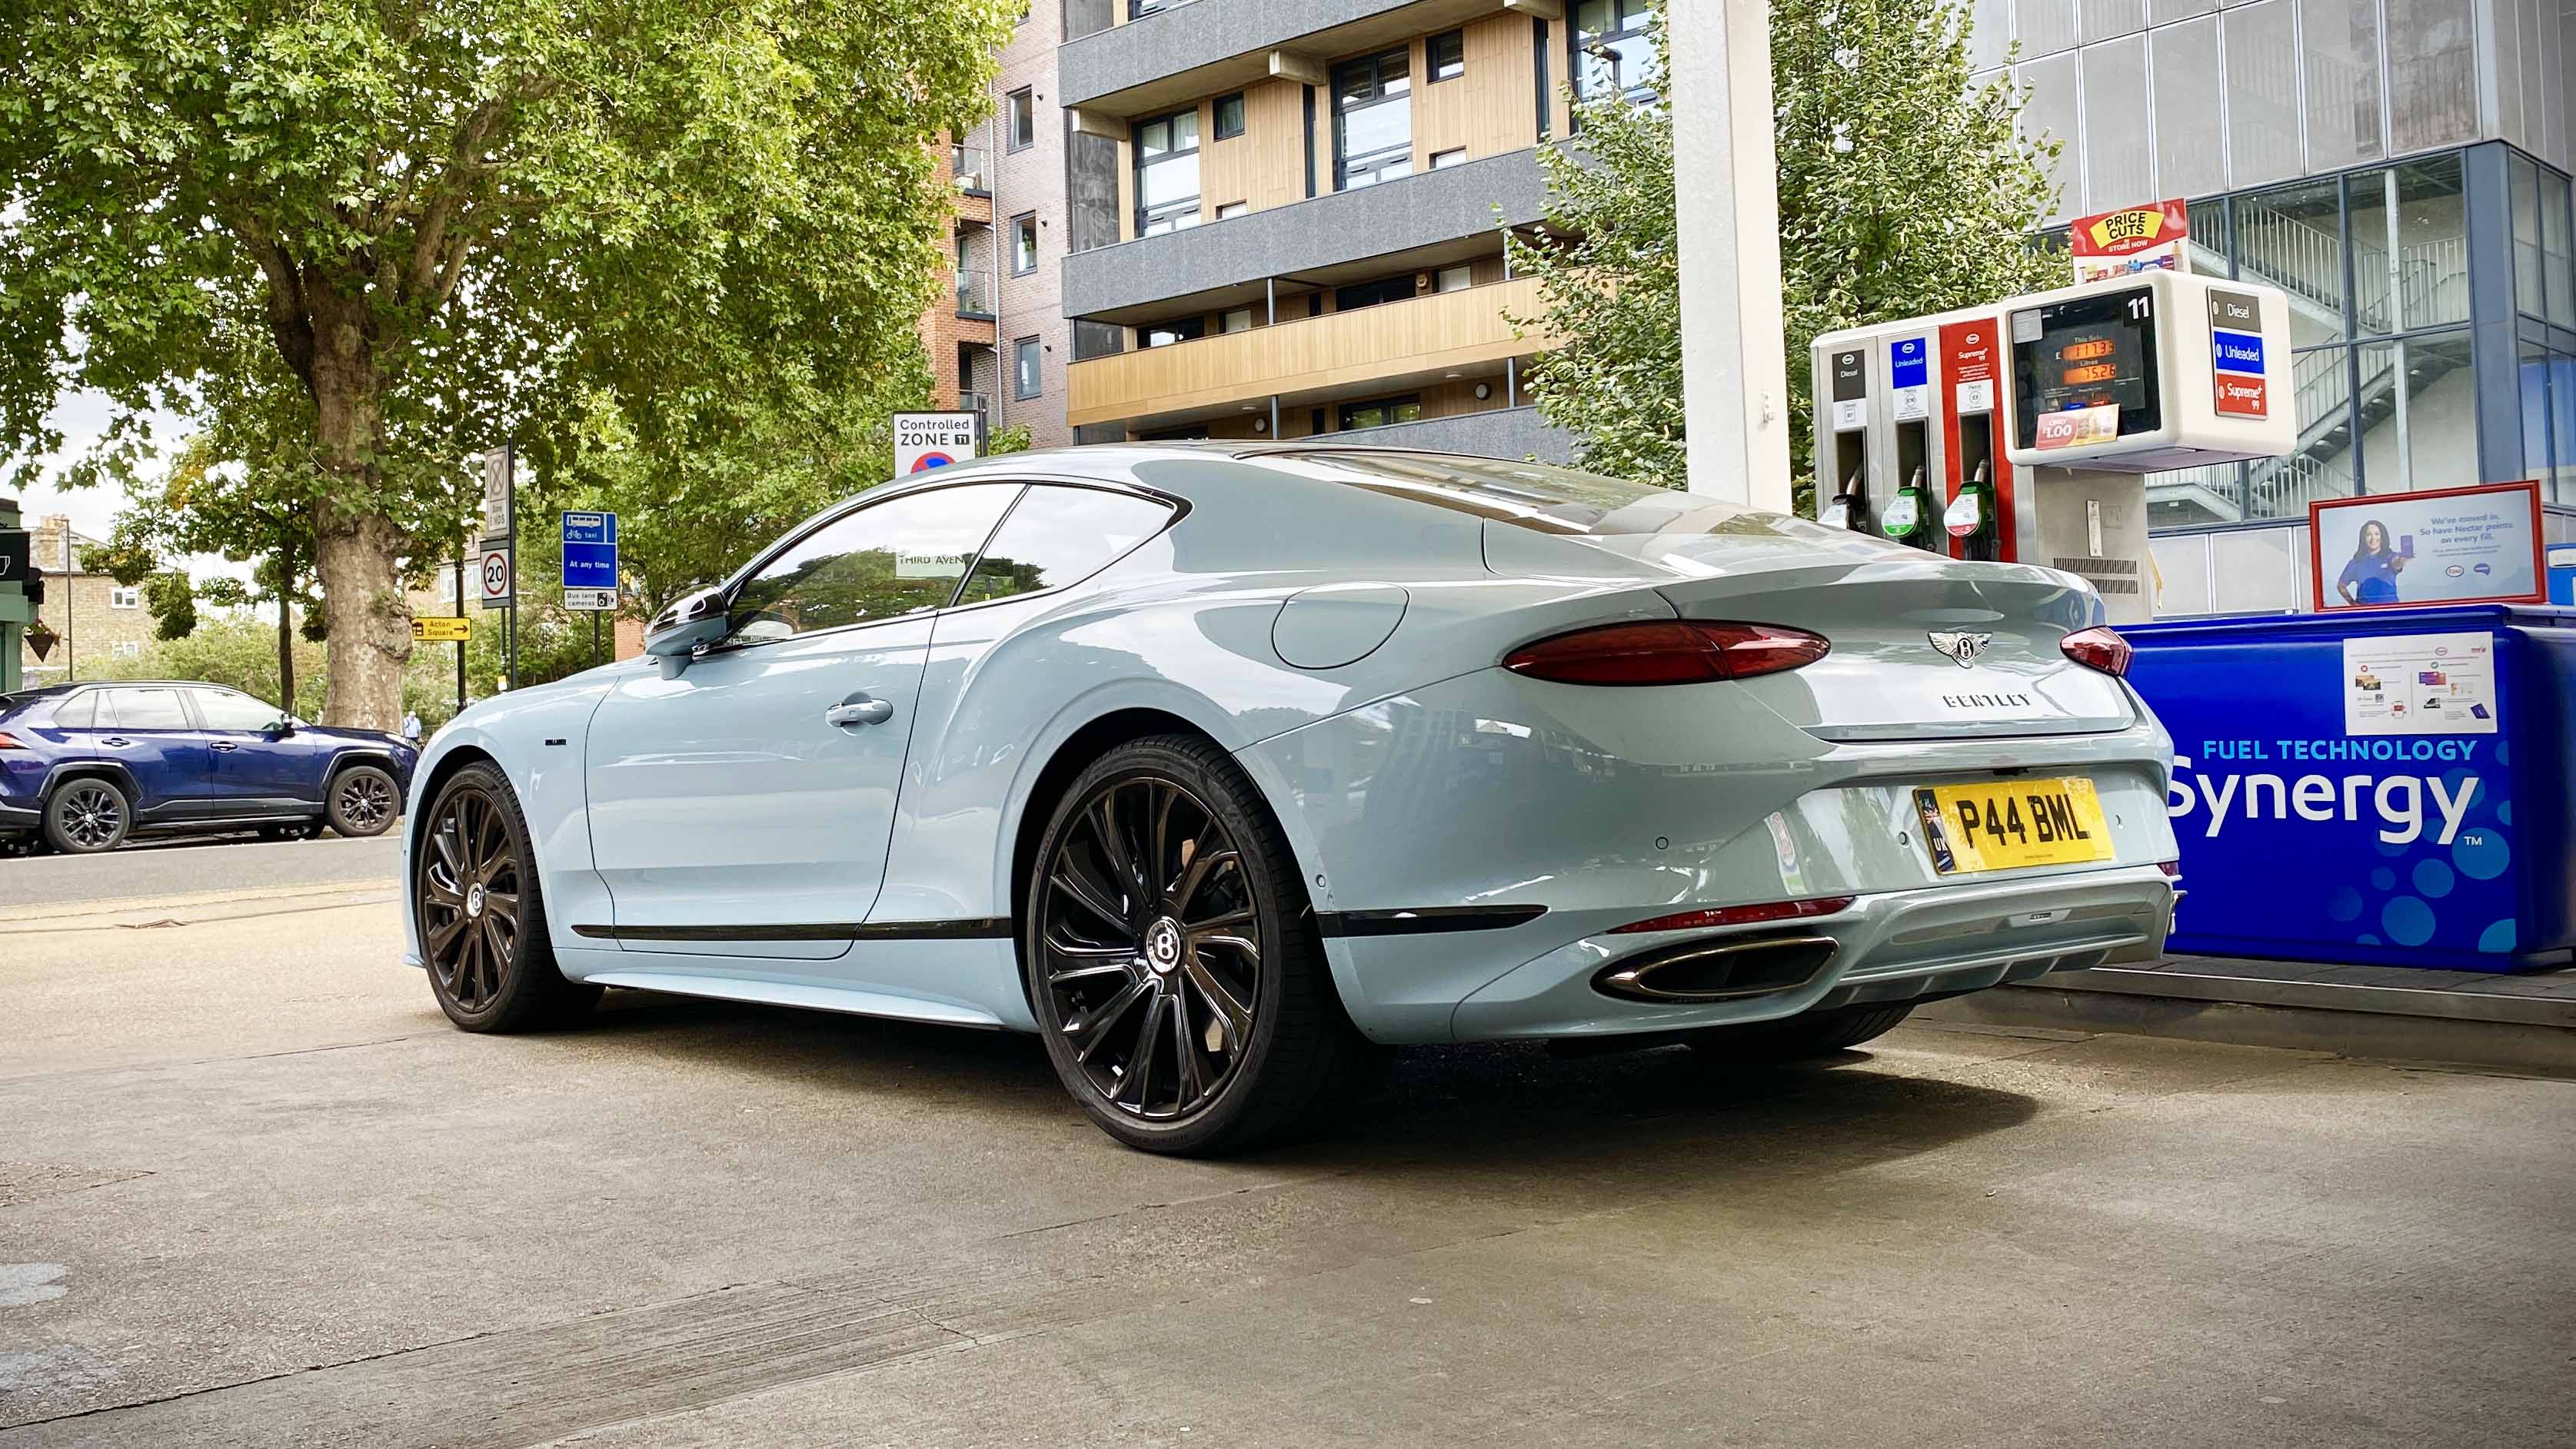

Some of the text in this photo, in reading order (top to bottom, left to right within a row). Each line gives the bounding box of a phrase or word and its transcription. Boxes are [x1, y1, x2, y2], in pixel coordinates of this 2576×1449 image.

[2105, 212, 2147, 230] PRICE
[2108, 224, 2145, 239] CUTS
[2108, 243, 2130, 252] STORE
[2128, 296, 2149, 320] 11
[2227, 303, 2250, 319] Diesel
[2225, 344, 2259, 362] Unleaded
[1895, 357, 1924, 367] Unleaded
[1839, 369, 1858, 378] Diesel
[2252, 398, 2260, 410] 99
[900, 419, 969, 430] Controlled
[900, 433, 949, 446] ZONE
[2459, 513, 2487, 523] moved
[2455, 524, 2483, 533] Nectar
[595, 560, 610, 569] time
[898, 555, 930, 565] THIRD
[488, 565, 504, 583] 20
[1942, 693, 2030, 708] BENTLEY
[2203, 739, 2478, 760] FUEL TECHNOLOGY
[2166, 754, 2480, 846] Synergy
[1955, 793, 2092, 849] P44 BML
[1933, 837, 1949, 852] UK
